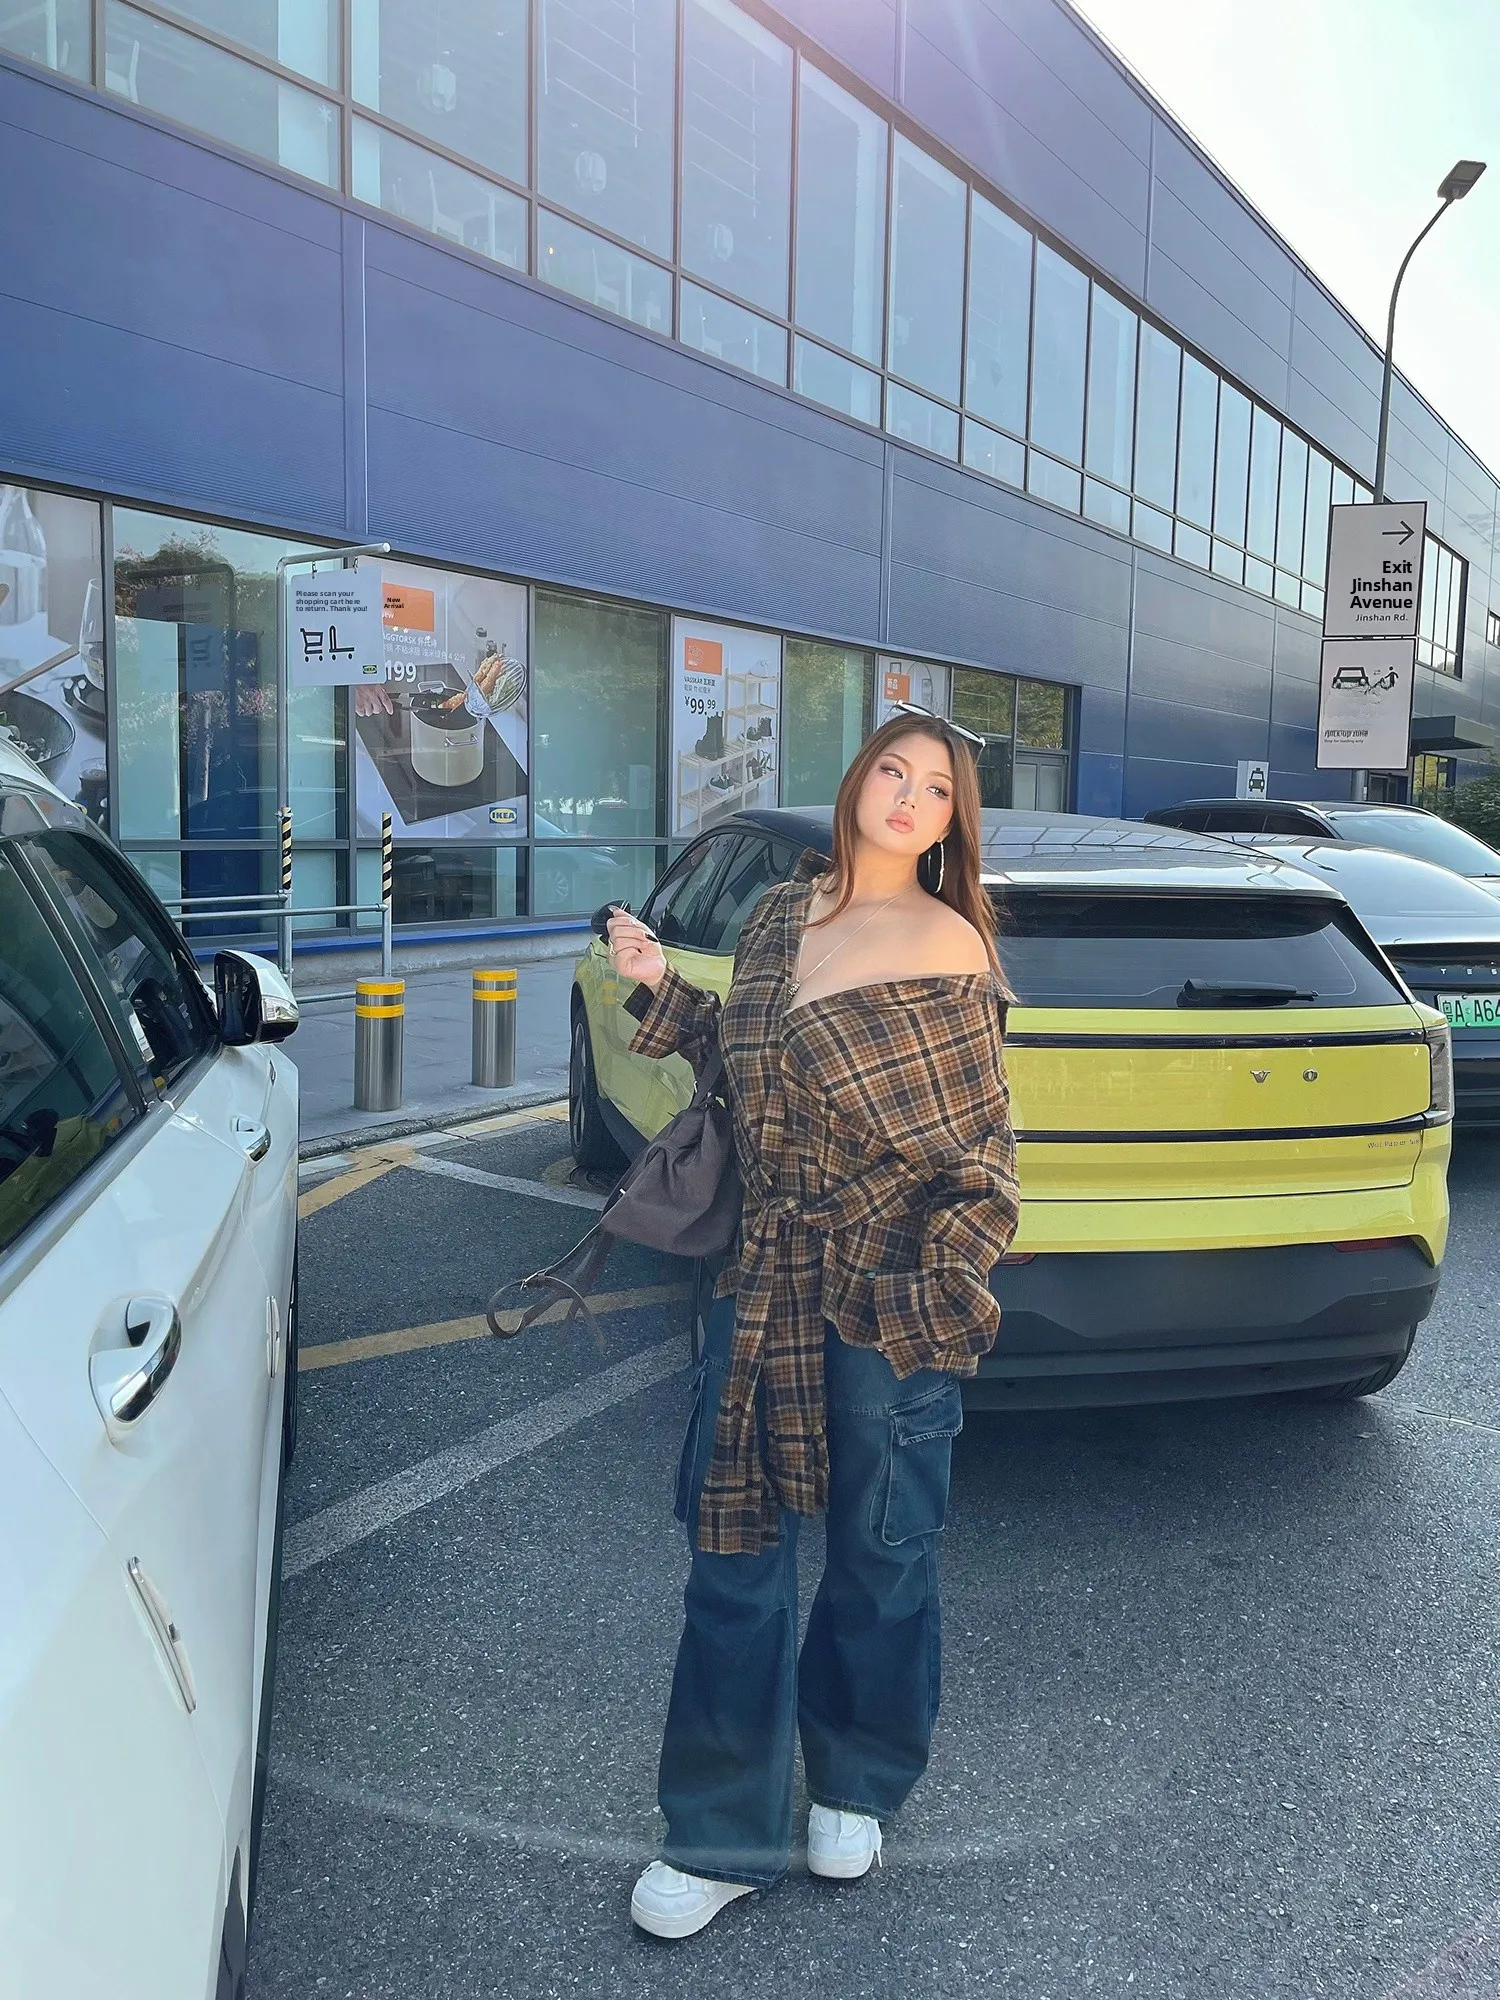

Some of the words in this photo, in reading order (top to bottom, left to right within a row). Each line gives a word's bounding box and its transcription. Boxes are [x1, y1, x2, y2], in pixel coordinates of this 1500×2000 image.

[1382, 560, 1412, 573] Exit
[1350, 578, 1412, 594] Jinshan
[1350, 596, 1412, 608] Avenue
[1355, 613, 1391, 621] Jinshan
[1393, 613, 1408, 621] Rd.
[385, 660, 417, 683] 199
